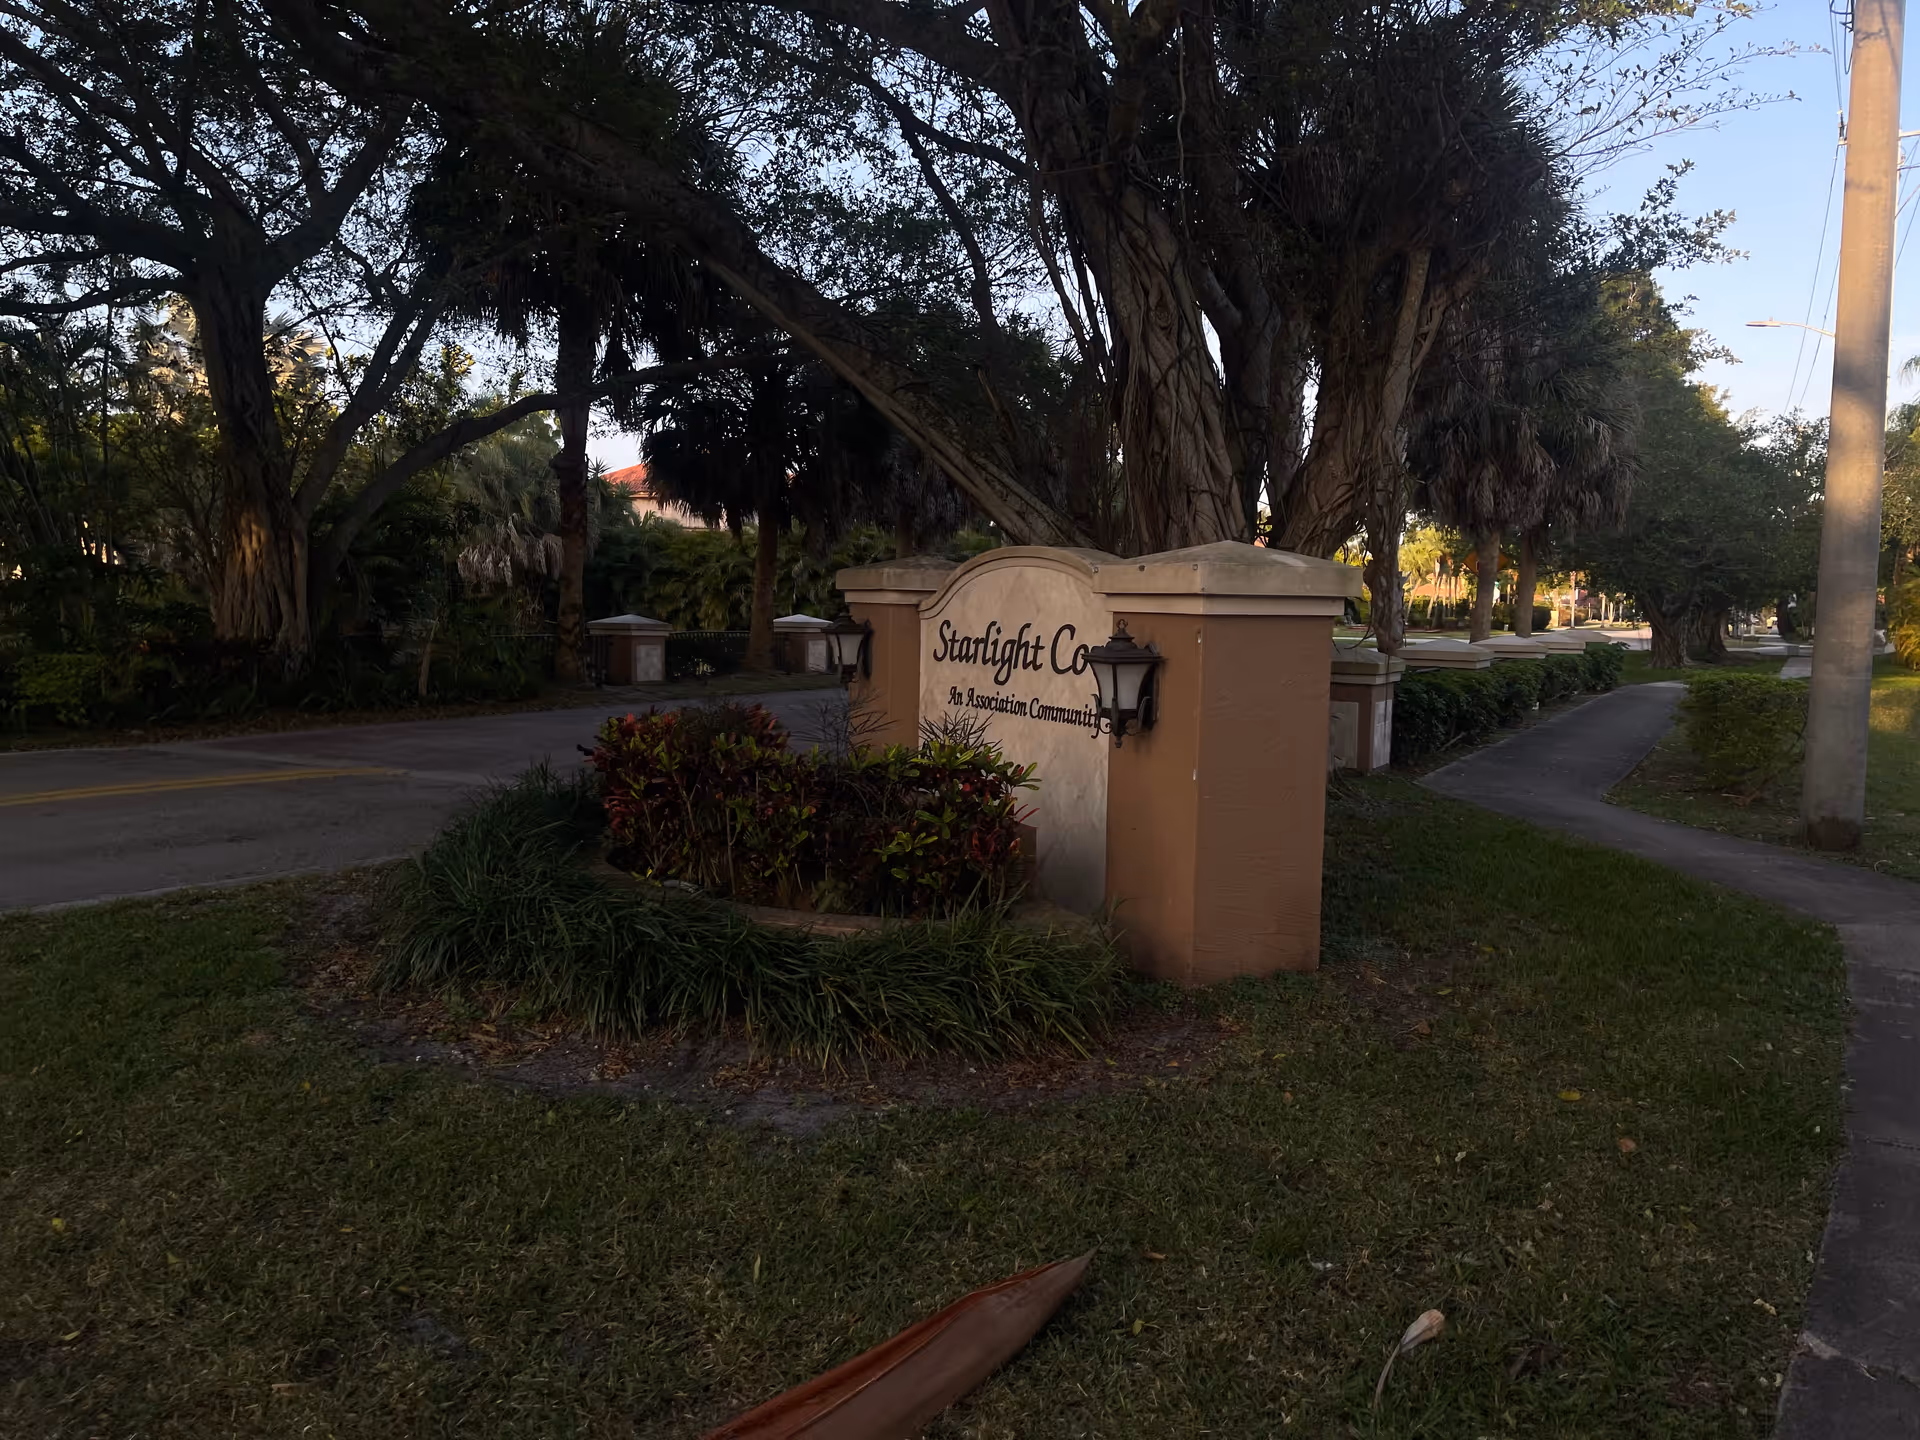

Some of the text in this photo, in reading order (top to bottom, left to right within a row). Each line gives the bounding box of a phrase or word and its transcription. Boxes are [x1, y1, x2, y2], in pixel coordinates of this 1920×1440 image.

[934, 619, 1100, 685] Starlight Co
[948, 686, 1101, 738] An Association Community
